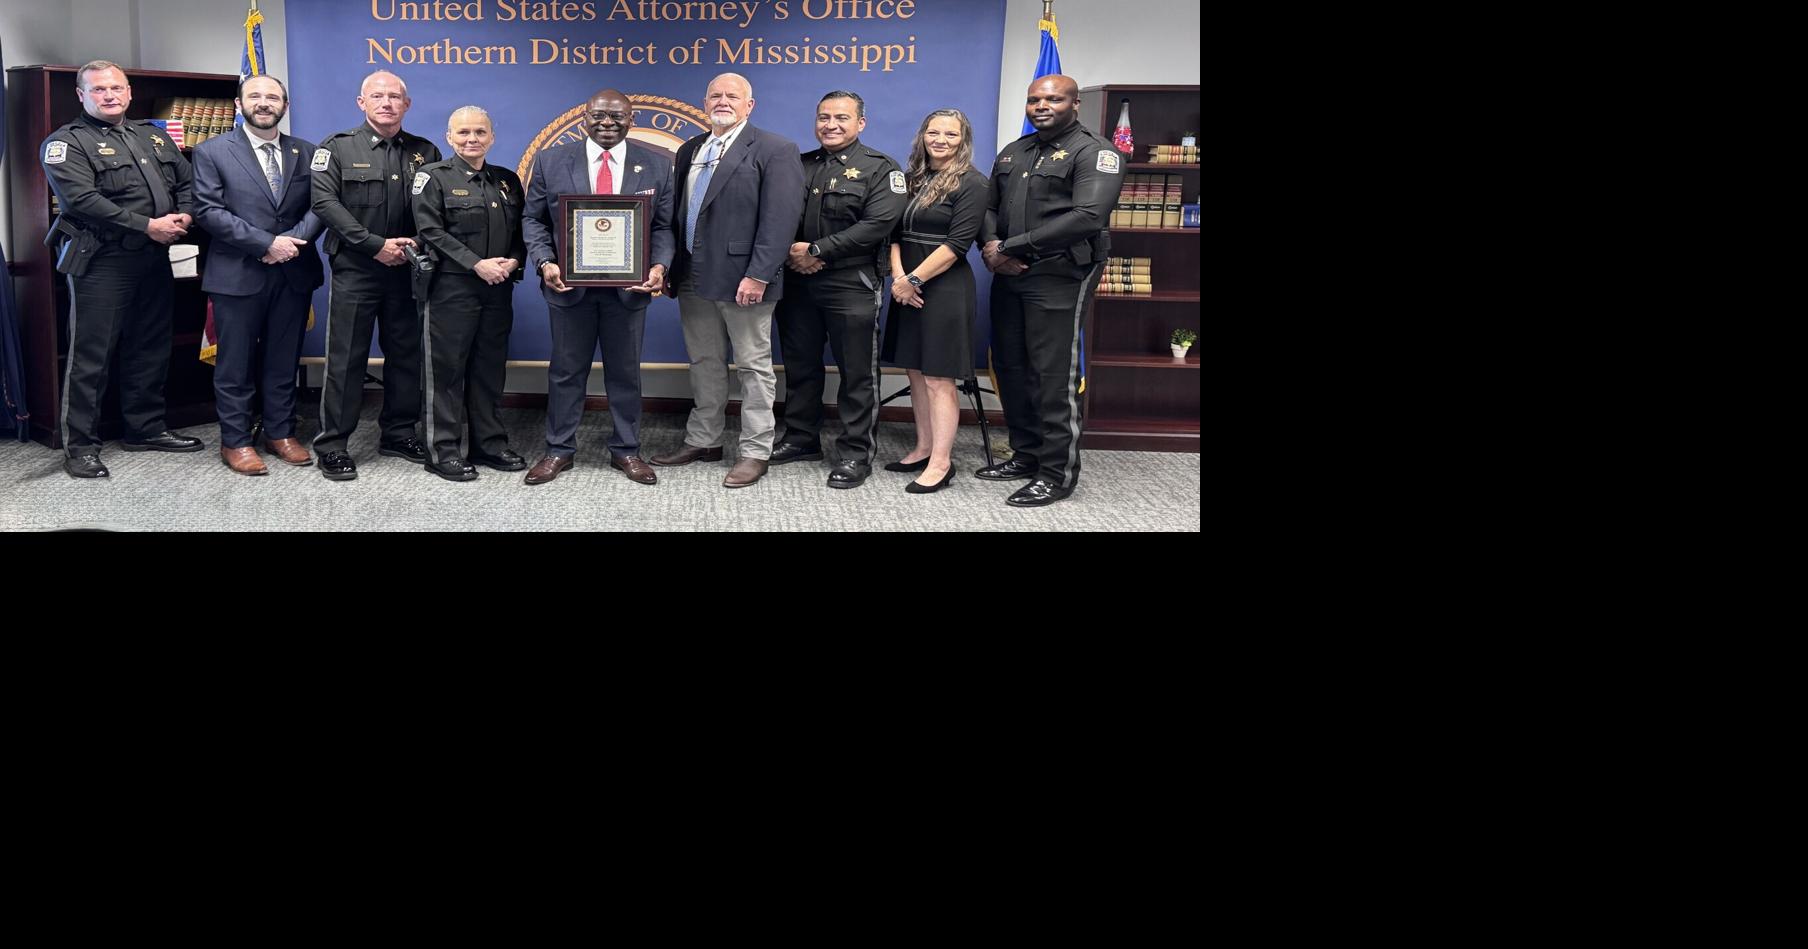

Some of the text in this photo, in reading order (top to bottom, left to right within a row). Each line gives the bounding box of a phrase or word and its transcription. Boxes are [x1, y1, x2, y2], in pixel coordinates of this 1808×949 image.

[370, 0, 484, 21] United
[496, 0, 597, 21] States
[801, 0, 916, 20] Office
[366, 36, 917, 72] Northern District of Mississippi
[651, 112, 688, 134] OF
